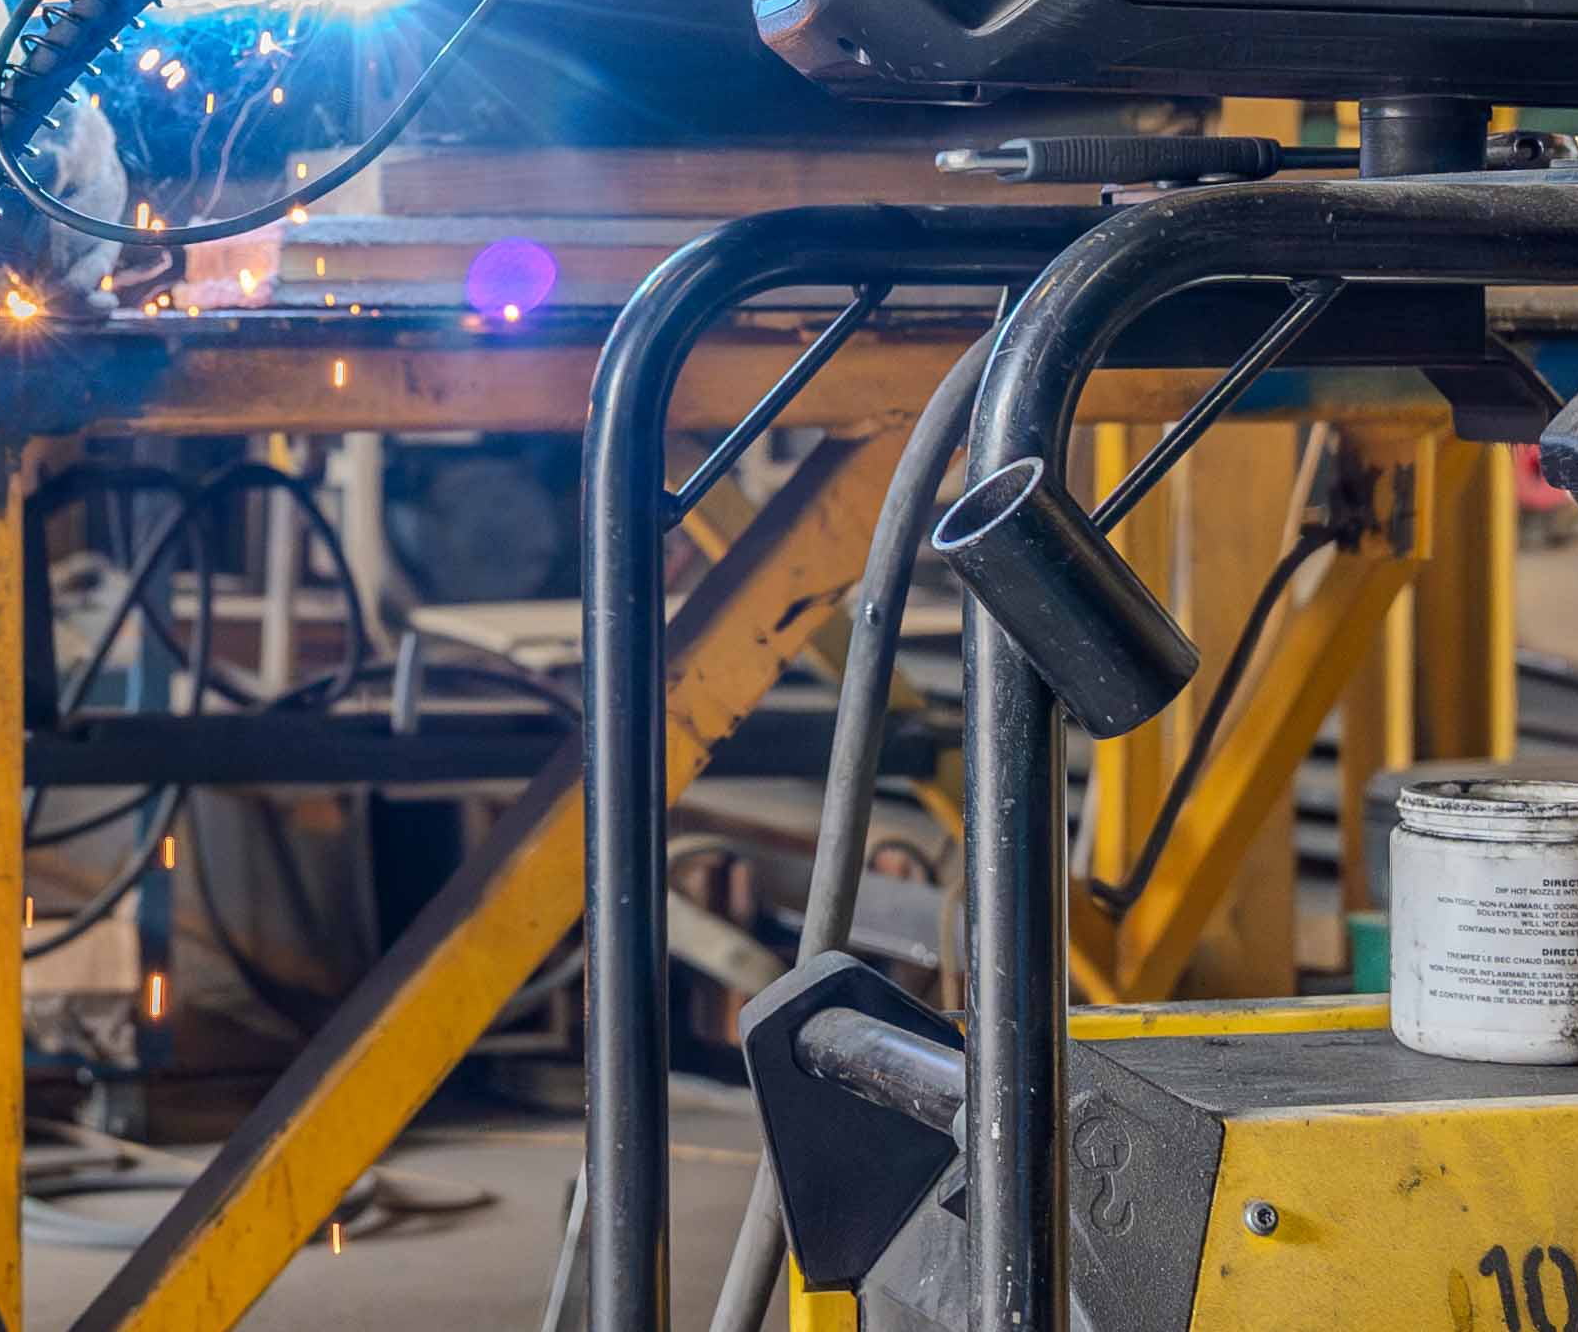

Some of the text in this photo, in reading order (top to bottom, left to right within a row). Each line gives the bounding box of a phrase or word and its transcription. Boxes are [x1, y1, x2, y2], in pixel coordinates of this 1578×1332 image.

[1511, 887, 1528, 895] HOT
[1530, 888, 1561, 896] NOZZLE
[1520, 911, 1540, 919] WILL
[1542, 911, 1558, 919] NOT
[1521, 920, 1540, 928] WILL
[1542, 920, 1558, 928] NOT
[1458, 924, 1496, 934] CONTAINS
[1498, 927, 1510, 936] NO
[1512, 957, 1541, 965] CHAUD
[1543, 958, 1566, 966] DANS
[1567, 957, 1578, 965] LA
[1541, 972, 1563, 980] SANS
[1537, 989, 1552, 997] PAS
[1476, 995, 1492, 1003] PAS
[1493, 997, 1505, 1005] DE
